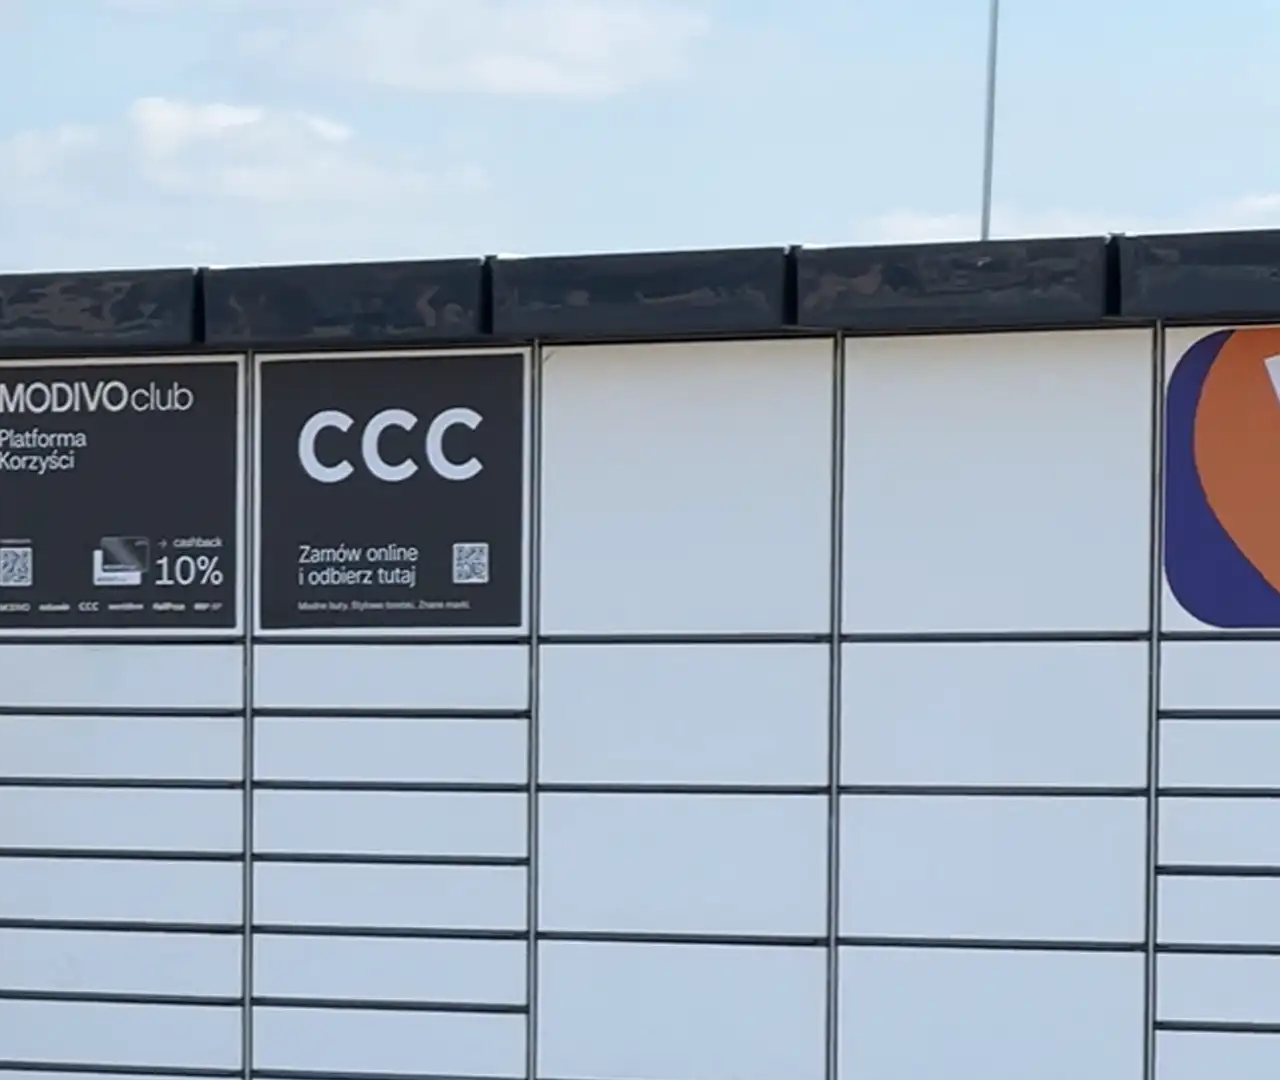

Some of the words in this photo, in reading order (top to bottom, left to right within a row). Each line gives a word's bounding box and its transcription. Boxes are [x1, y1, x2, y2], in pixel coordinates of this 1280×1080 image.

[298, 407, 484, 483] CCC
[172, 537, 223, 548] cashback
[299, 544, 362, 563] Zamów
[366, 544, 419, 562] online
[155, 556, 224, 585] 10%
[298, 567, 305, 585] i
[308, 566, 373, 585] odbierz
[378, 566, 416, 588] tutaj
